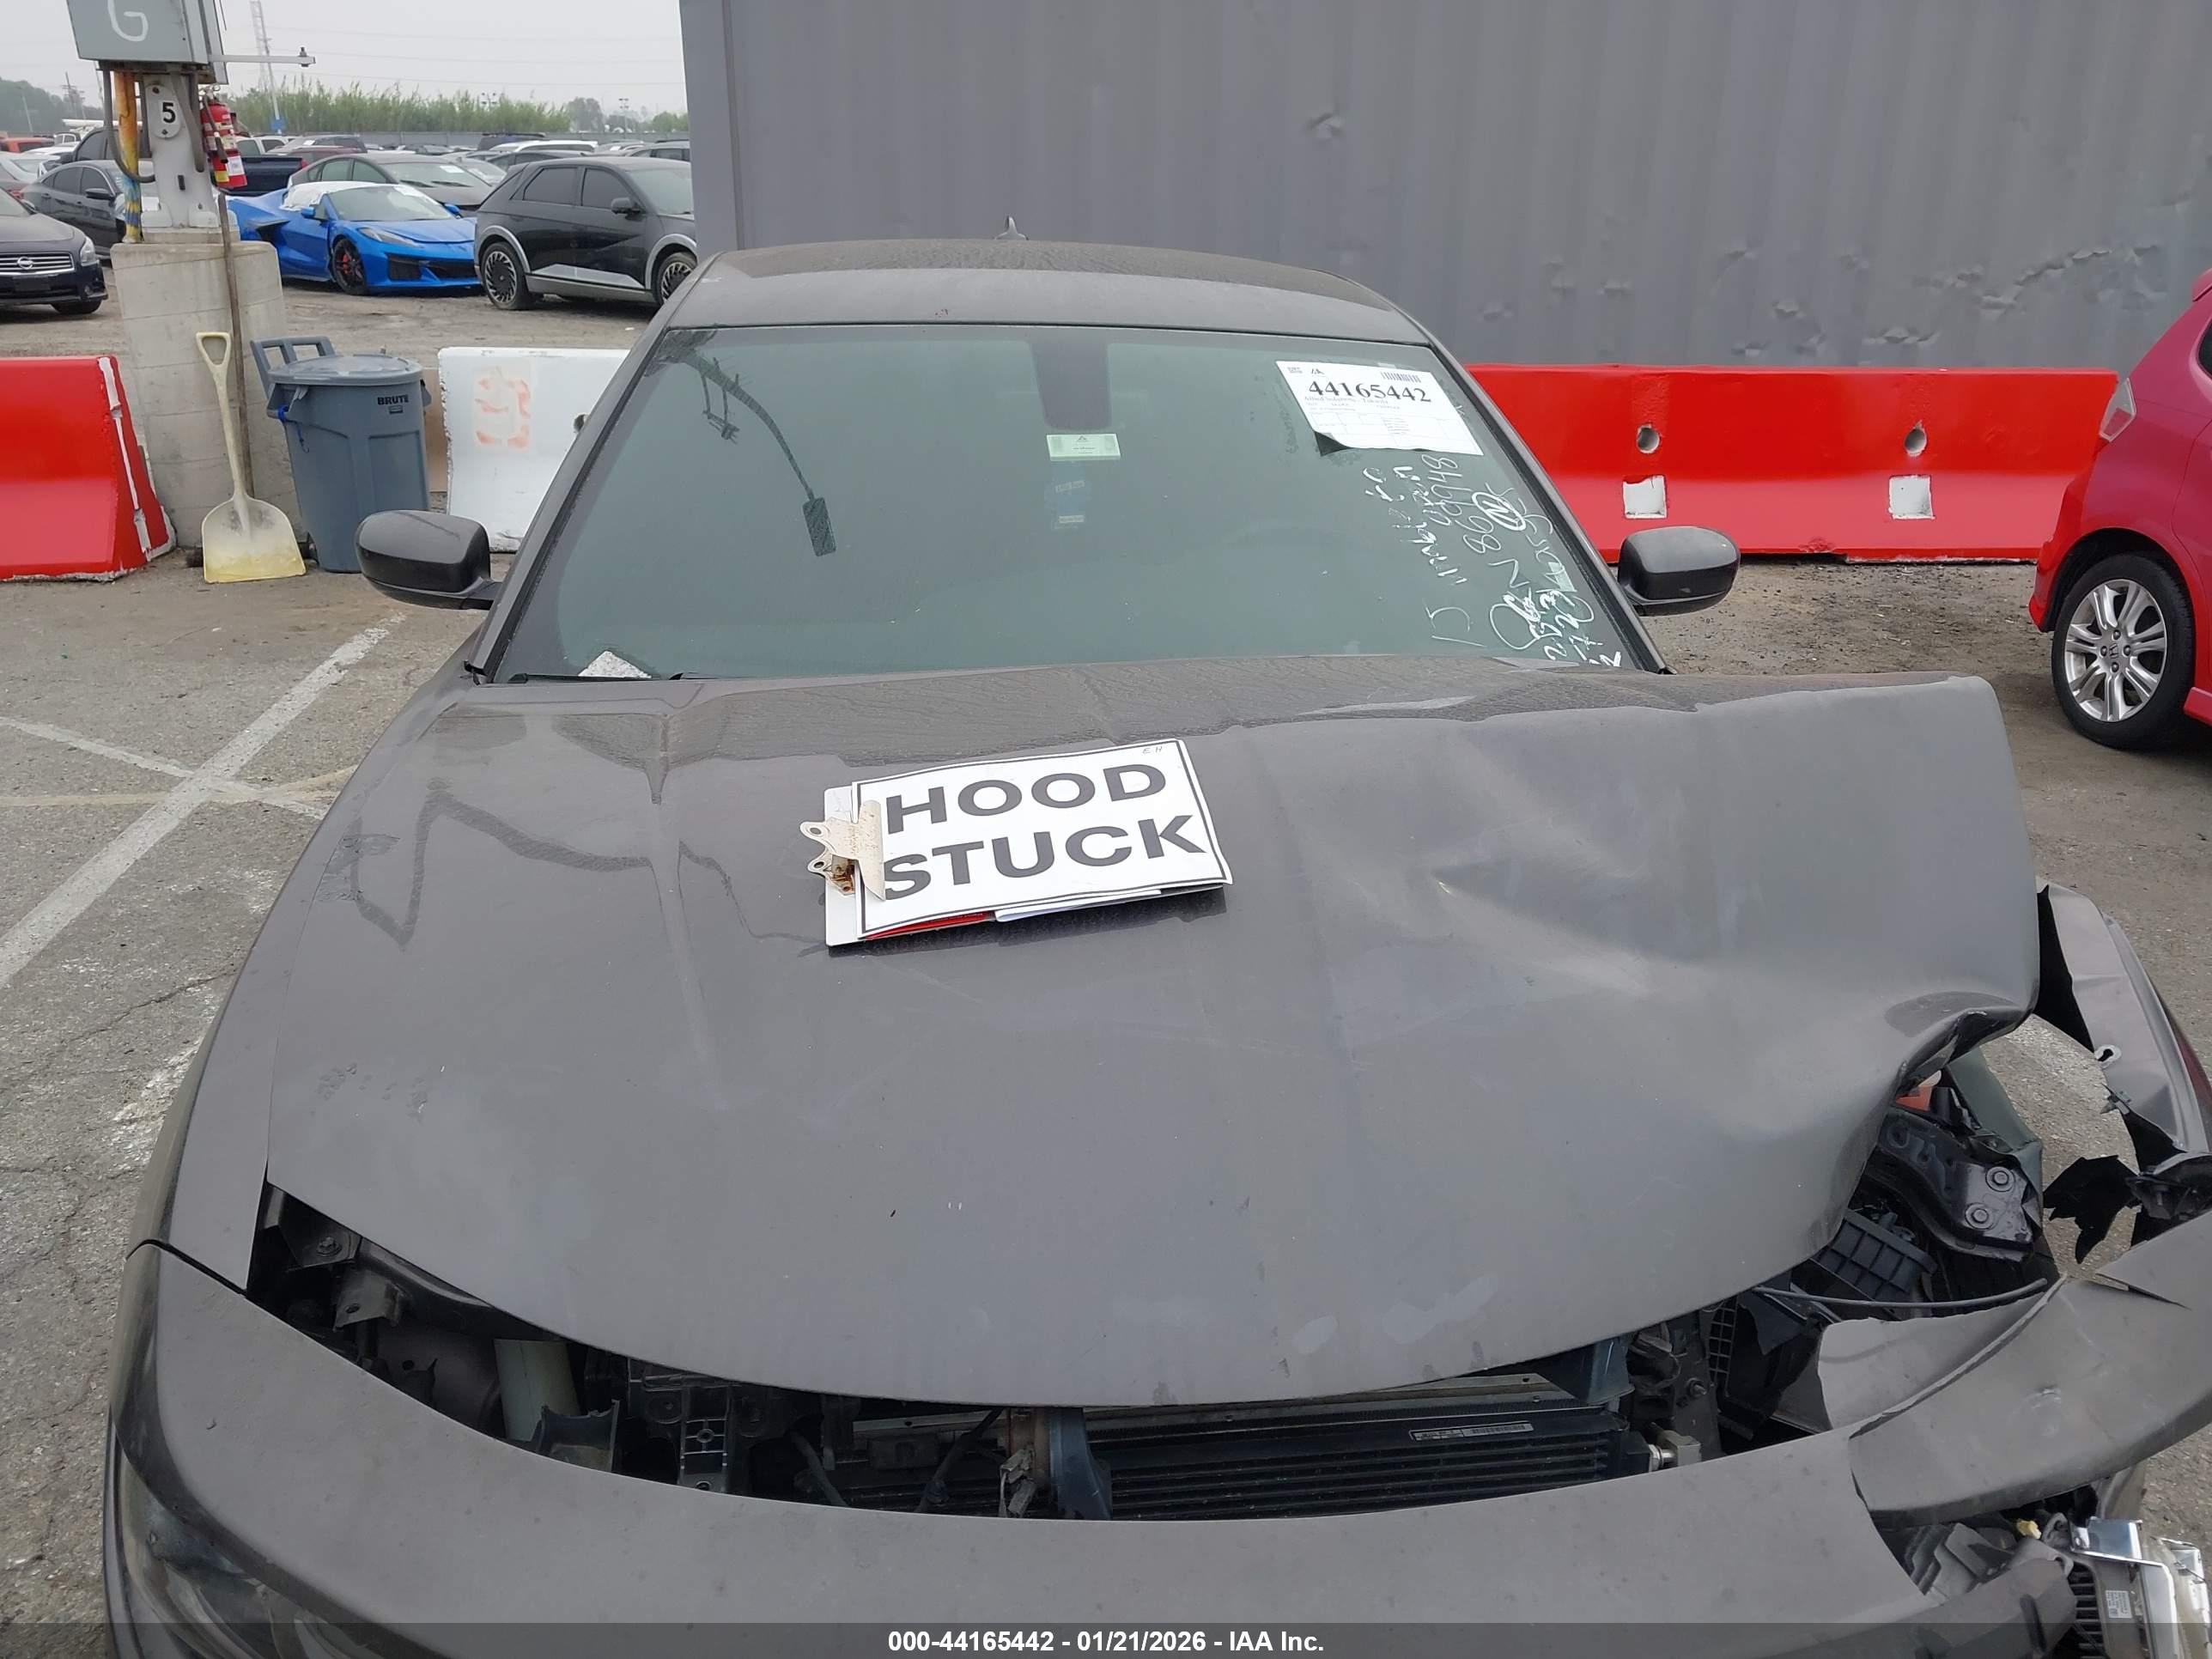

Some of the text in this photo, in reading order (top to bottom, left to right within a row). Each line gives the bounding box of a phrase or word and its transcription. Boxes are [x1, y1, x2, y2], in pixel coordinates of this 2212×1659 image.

[106, 0, 149, 42] G
[161, 101, 176, 124] 5
[377, 394, 410, 405] BRUTE
[1308, 380, 1432, 402] 44165442
[885, 763, 1166, 835] HOOD
[884, 814, 1208, 901] STUCK
